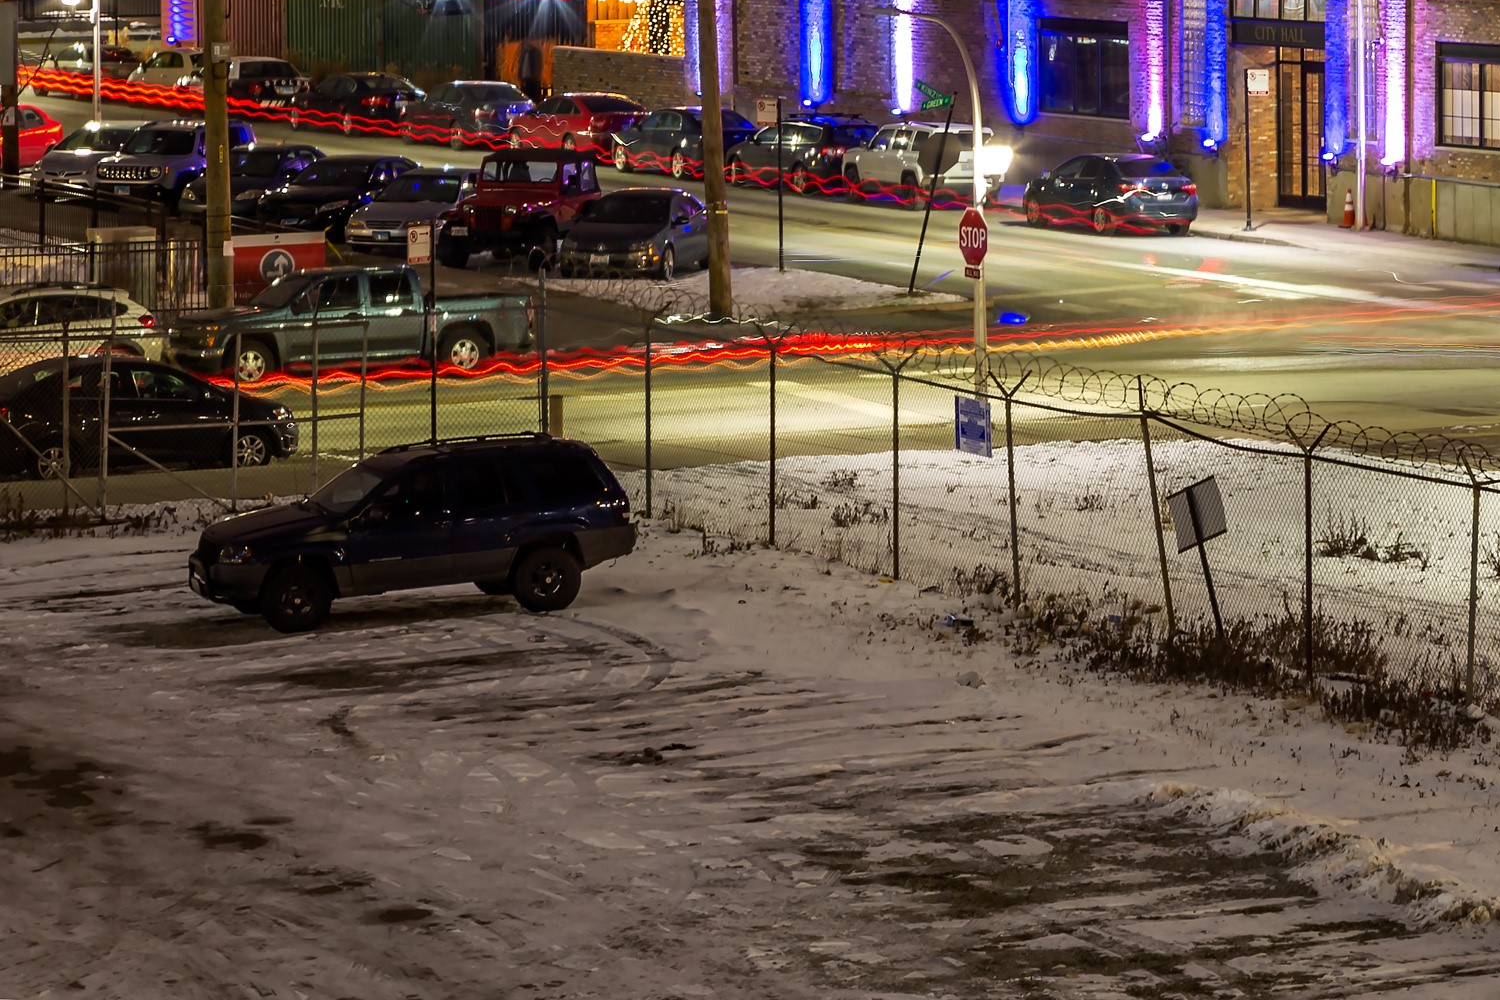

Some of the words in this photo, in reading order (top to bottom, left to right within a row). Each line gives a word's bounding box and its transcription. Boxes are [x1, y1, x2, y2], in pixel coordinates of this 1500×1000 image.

[1255, 25, 1276, 41] CITY
[1281, 27, 1306, 43] HALL
[927, 98, 943, 108] GREEN
[961, 226, 986, 249] STOP
